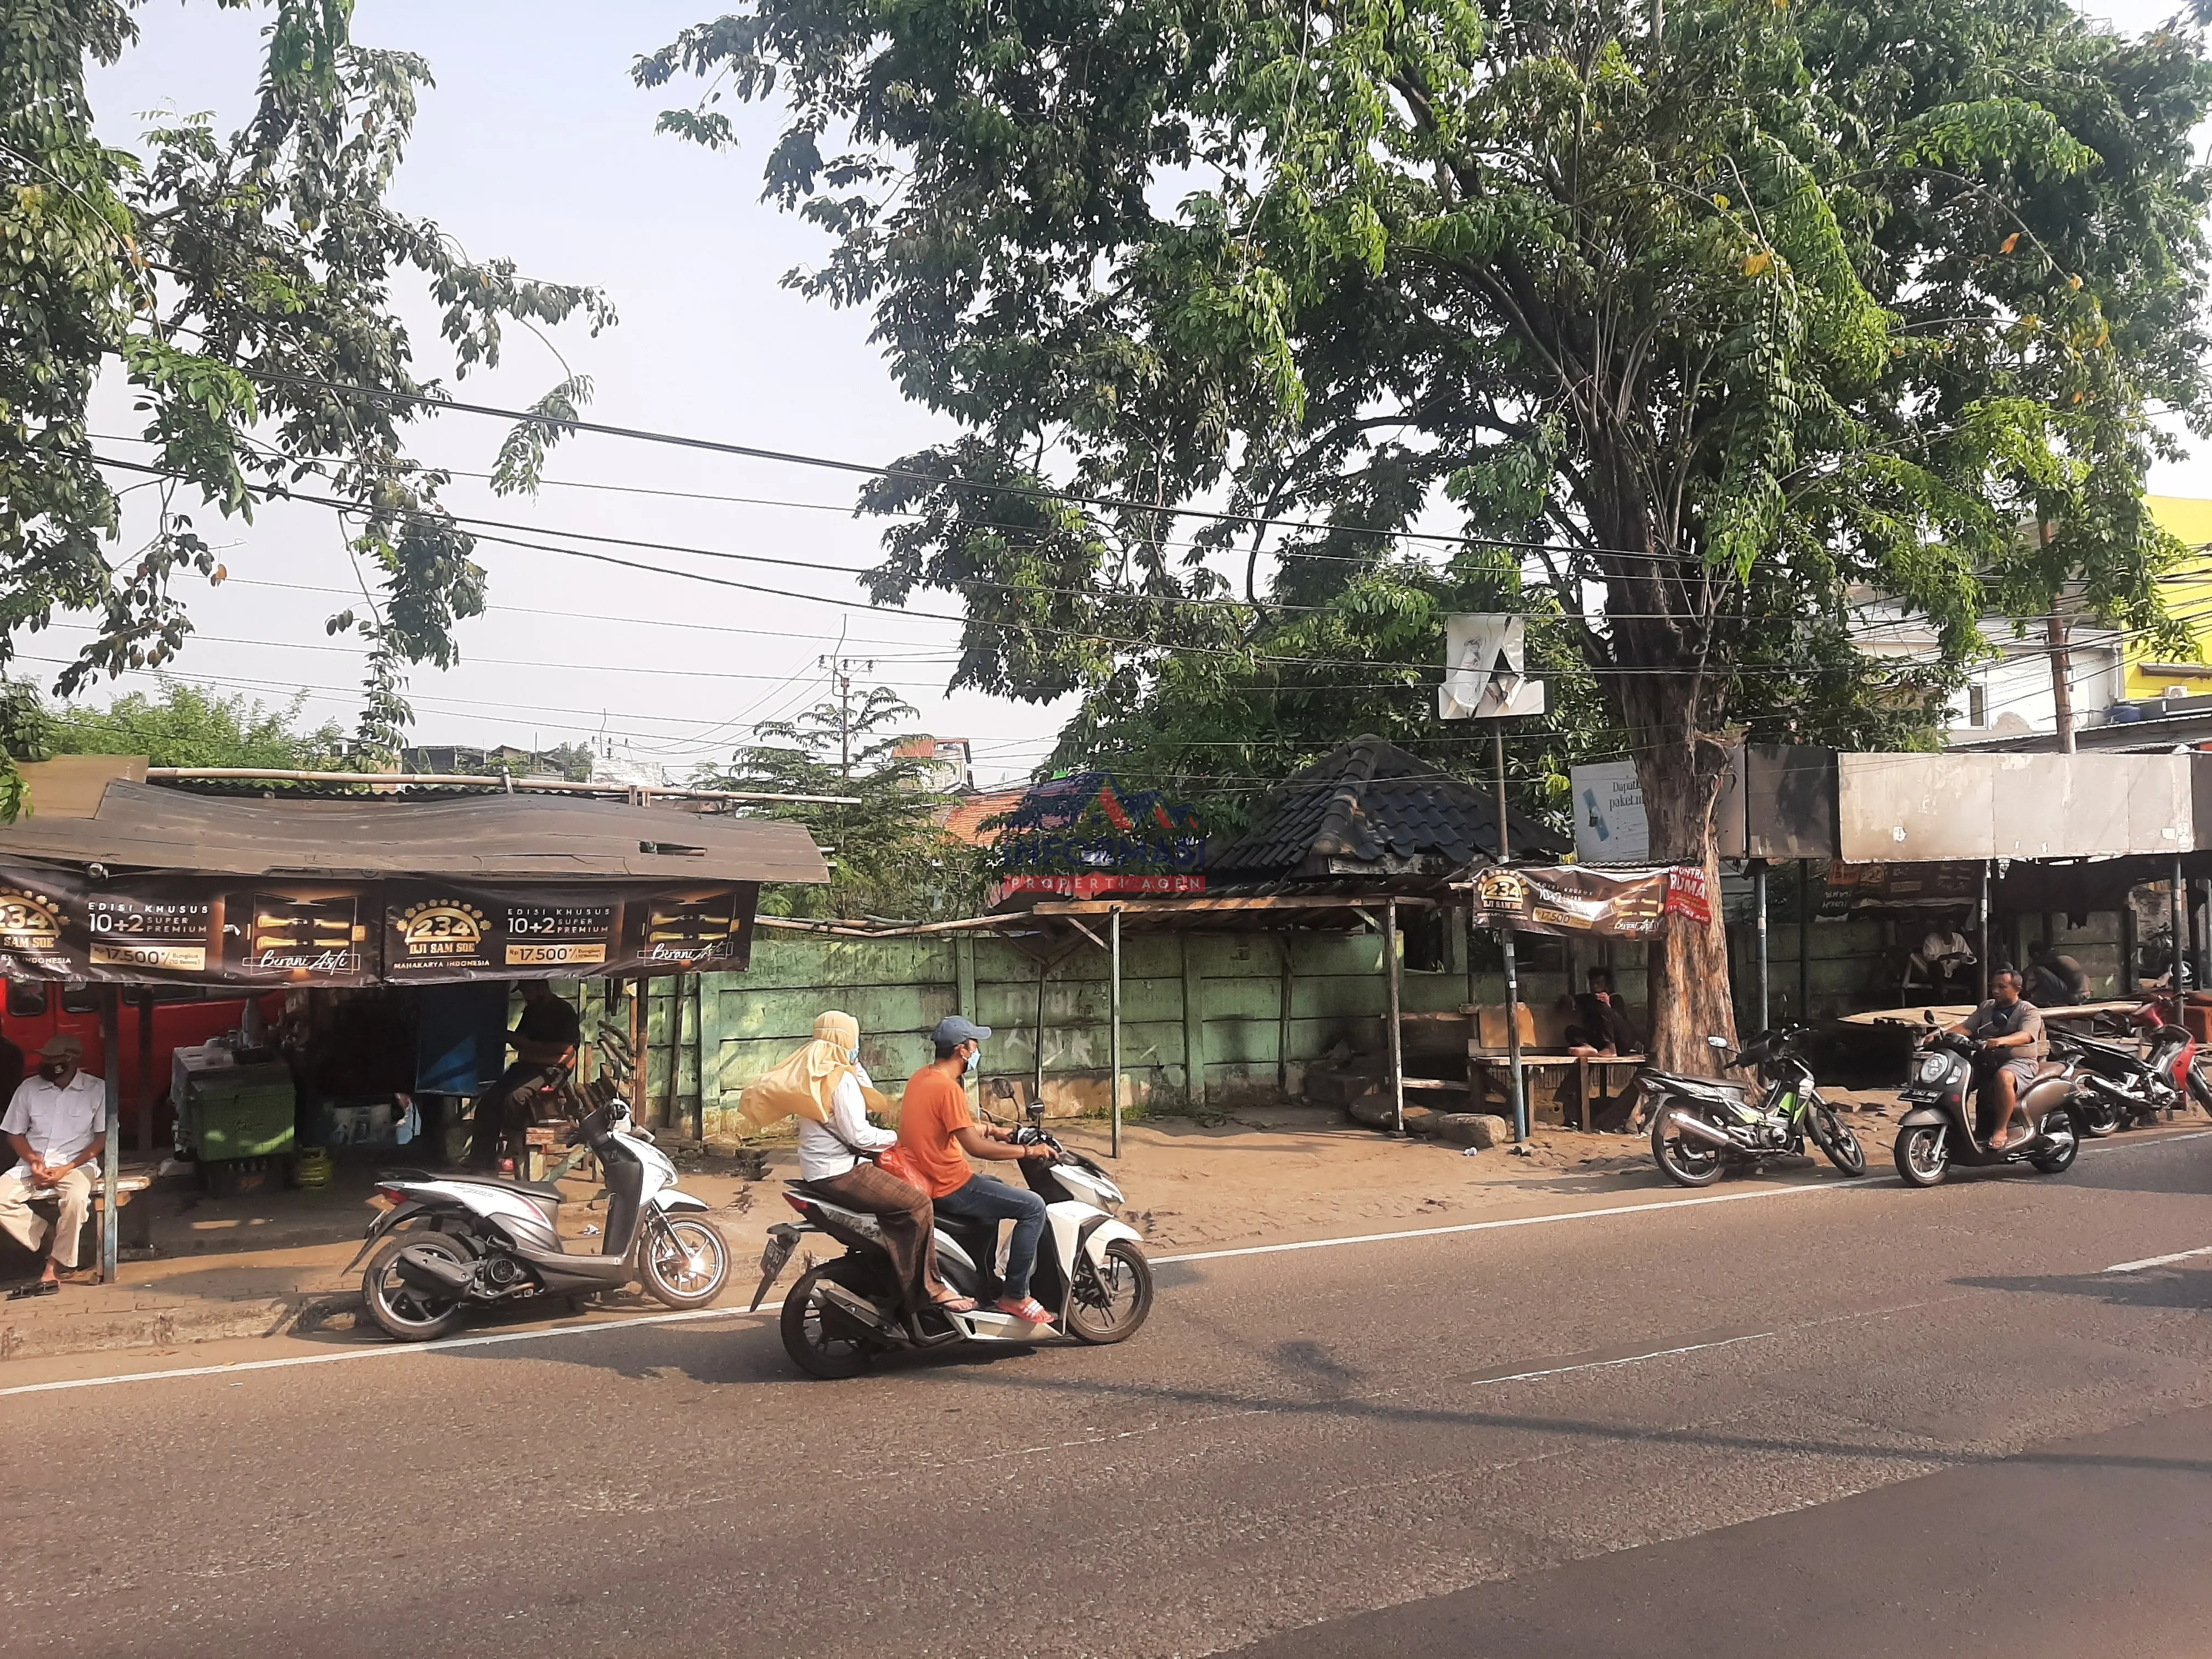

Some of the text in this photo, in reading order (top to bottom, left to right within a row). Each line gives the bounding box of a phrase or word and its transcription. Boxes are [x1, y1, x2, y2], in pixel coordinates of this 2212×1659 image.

[1609, 794, 1633, 811] paket
[1486, 882, 1521, 898] 234
[1669, 873, 1708, 900] RUMA
[88, 902, 208, 914] EDISI KHUSUS
[88, 913, 144, 933] 10+2
[414, 916, 471, 936] 234
[507, 917, 555, 934] 10+2
[4, 936, 55, 949] SAM SOE
[409, 943, 475, 955] DJI SAM SOE
[260, 949, 308, 968] Berani
[651, 943, 696, 960] Berani
